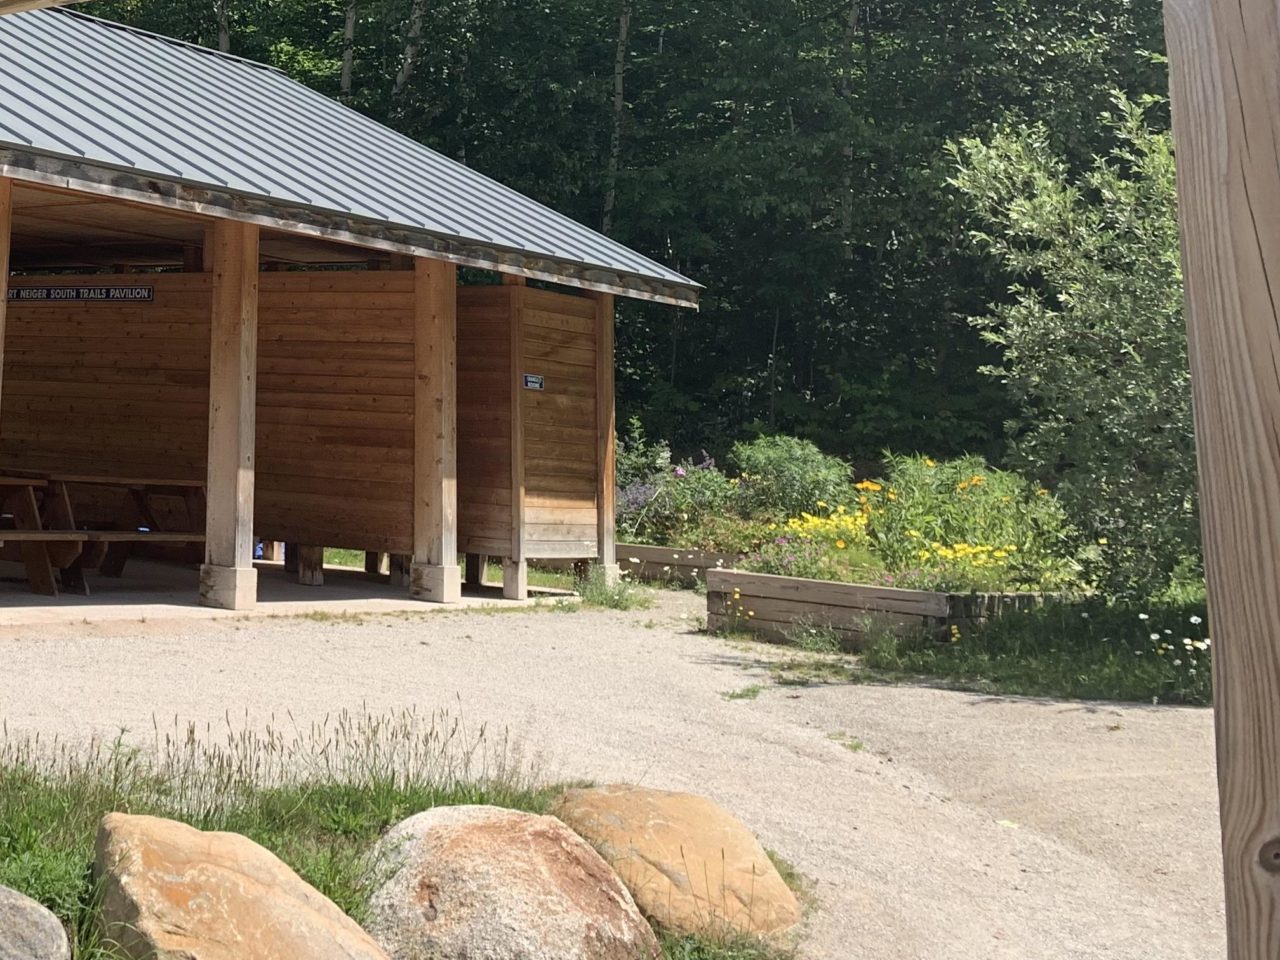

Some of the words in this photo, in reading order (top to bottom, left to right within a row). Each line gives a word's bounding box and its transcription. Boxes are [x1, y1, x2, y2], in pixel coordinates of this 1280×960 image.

[8, 289, 17, 298] RT
[20, 289, 47, 298] NEIGER
[50, 289, 76, 298] SOUTH
[79, 289, 106, 298] TRAILS
[110, 288, 148, 298] PAVILION
